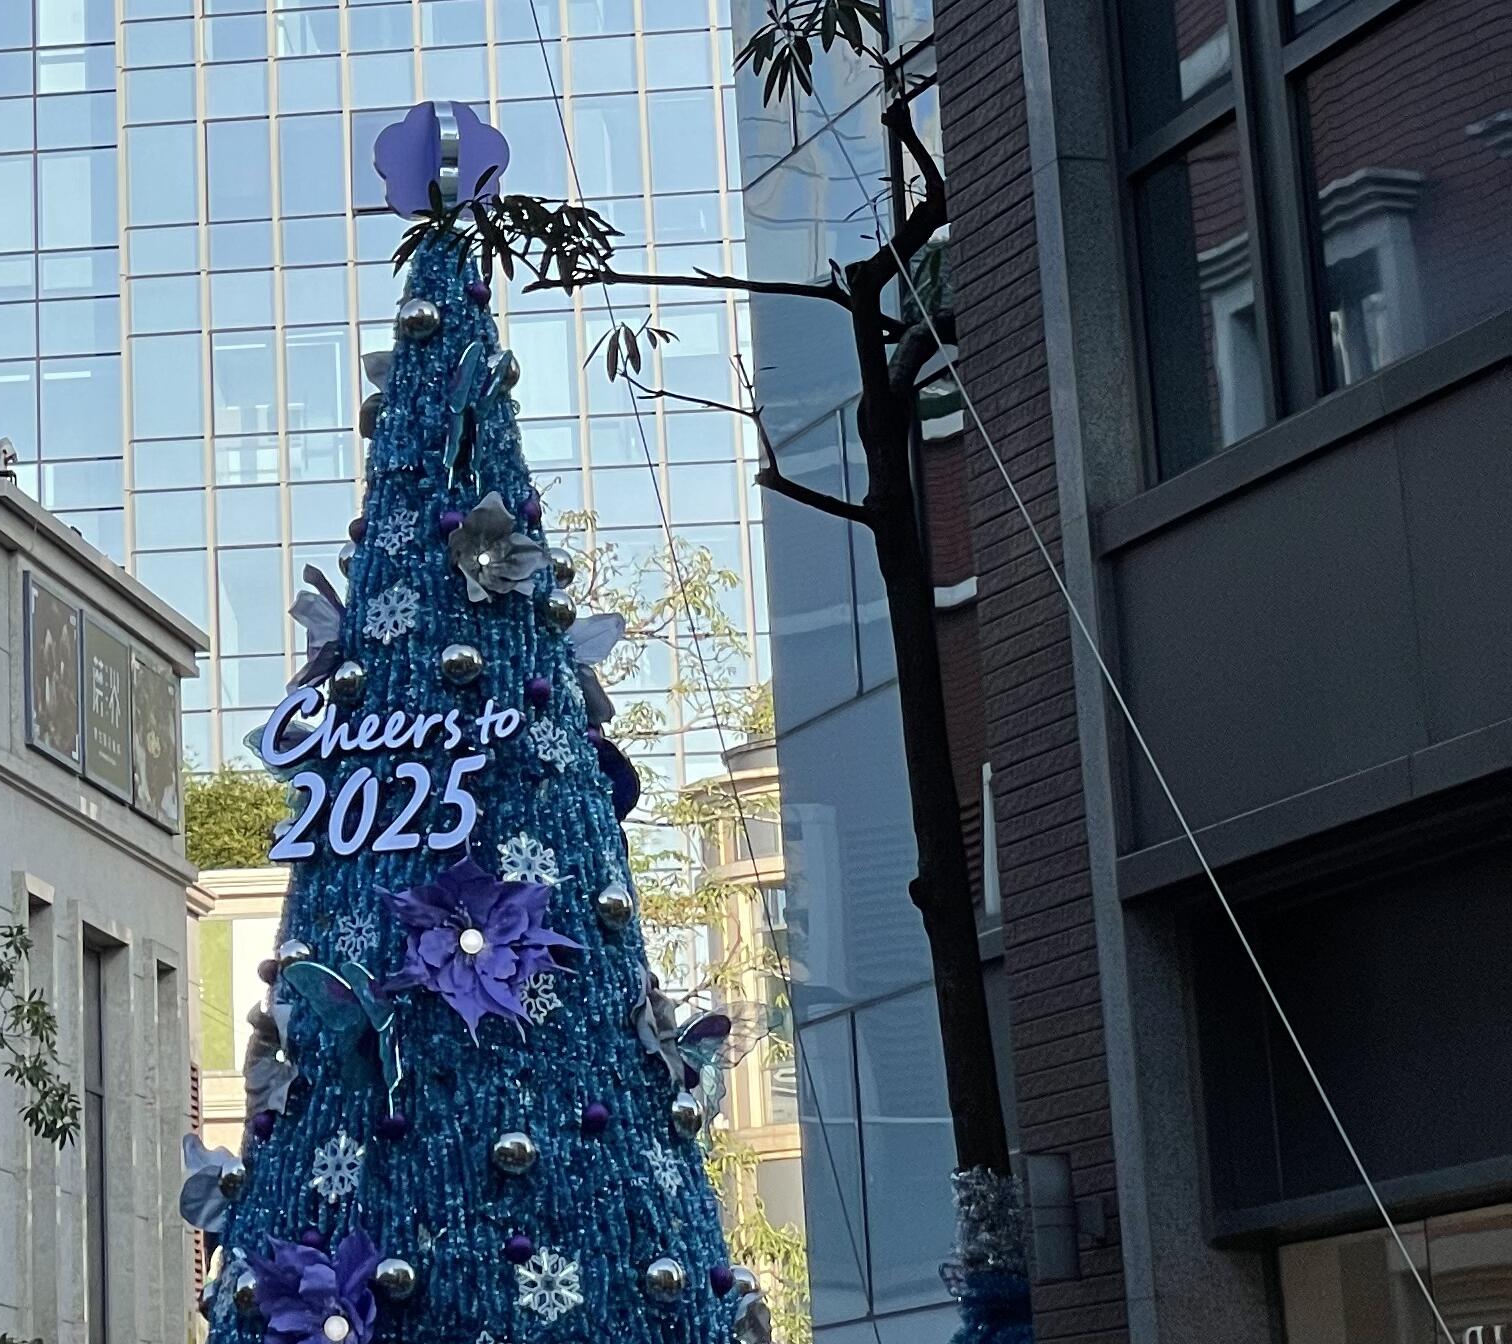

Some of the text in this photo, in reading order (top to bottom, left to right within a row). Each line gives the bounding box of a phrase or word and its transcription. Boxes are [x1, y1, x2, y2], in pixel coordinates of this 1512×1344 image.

[261, 686, 521, 767] Cheers to
[268, 754, 487, 861] 2025
